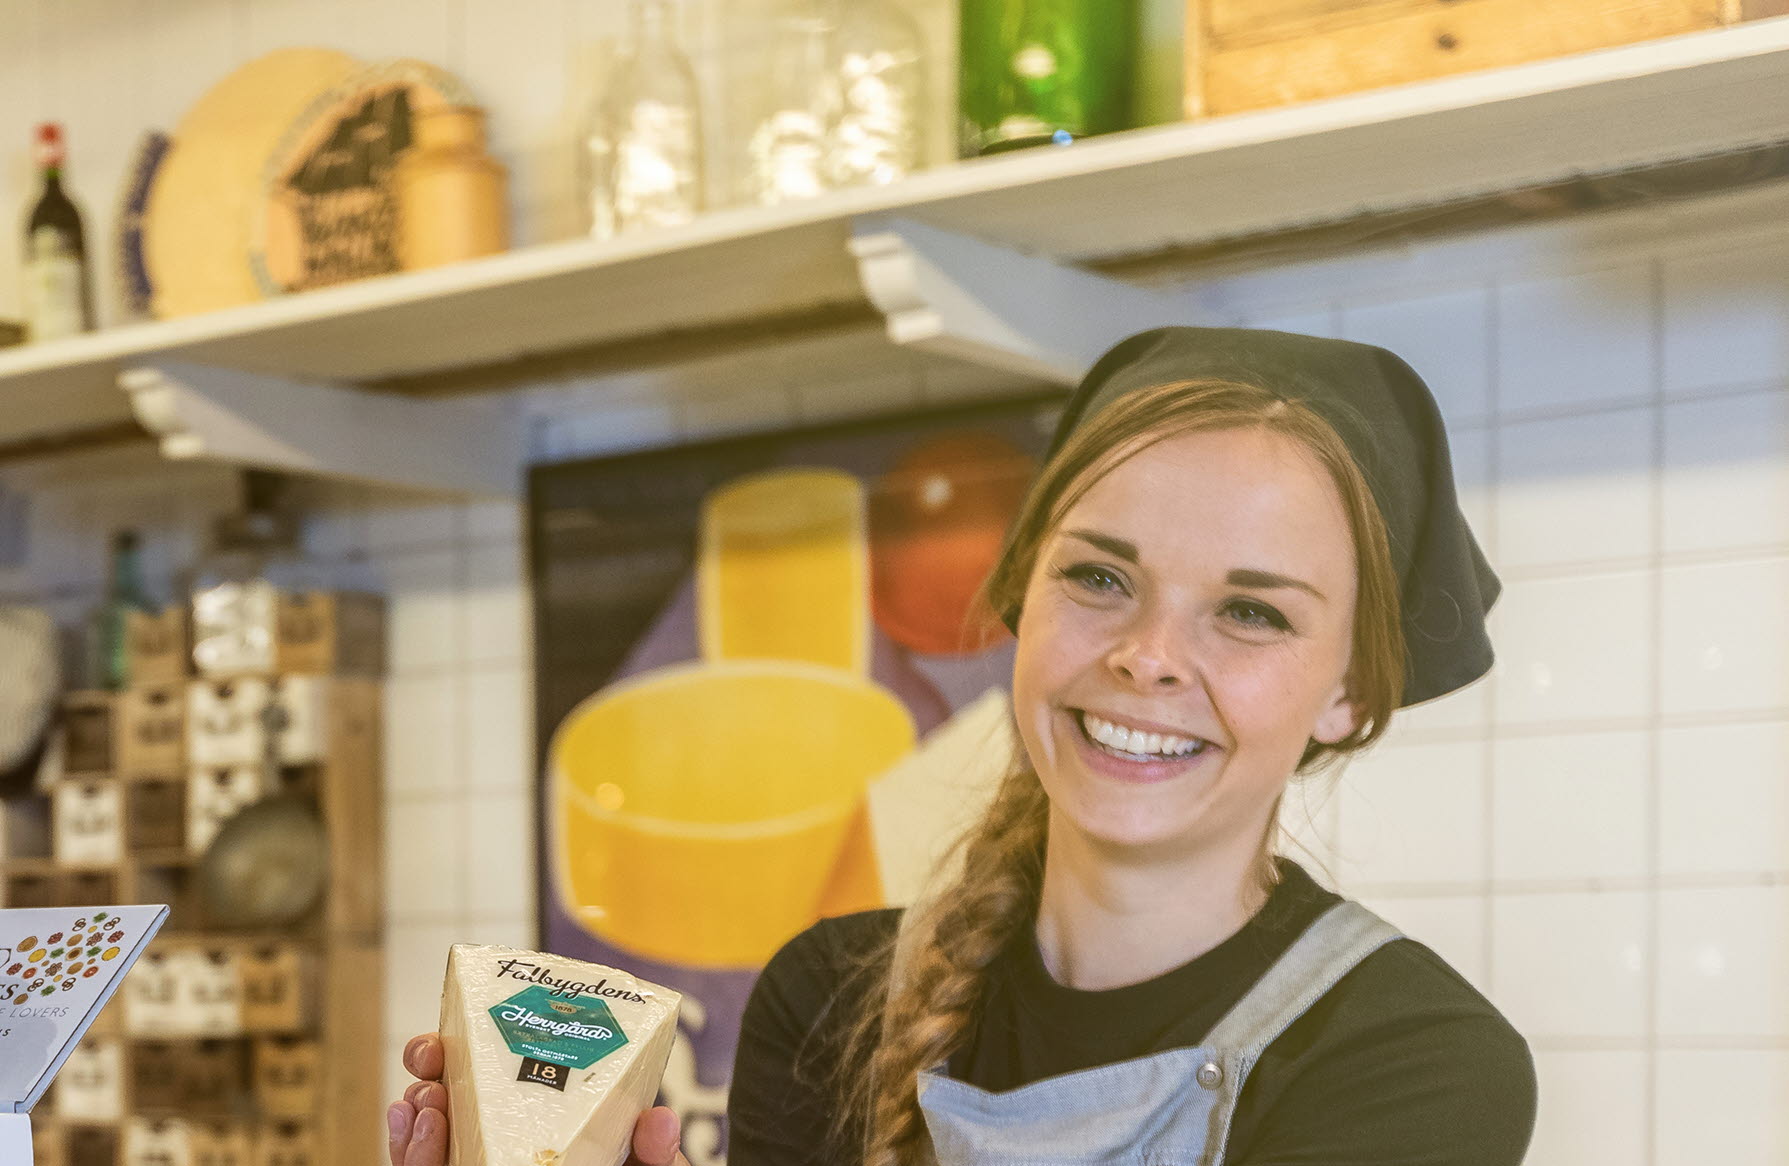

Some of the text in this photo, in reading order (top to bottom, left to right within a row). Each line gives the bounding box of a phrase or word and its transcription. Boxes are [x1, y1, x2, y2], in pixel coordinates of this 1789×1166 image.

[497, 959, 646, 1004] Falbygdens
[9, 1007, 69, 1018] LOVERS
[532, 1062, 557, 1079] 18
